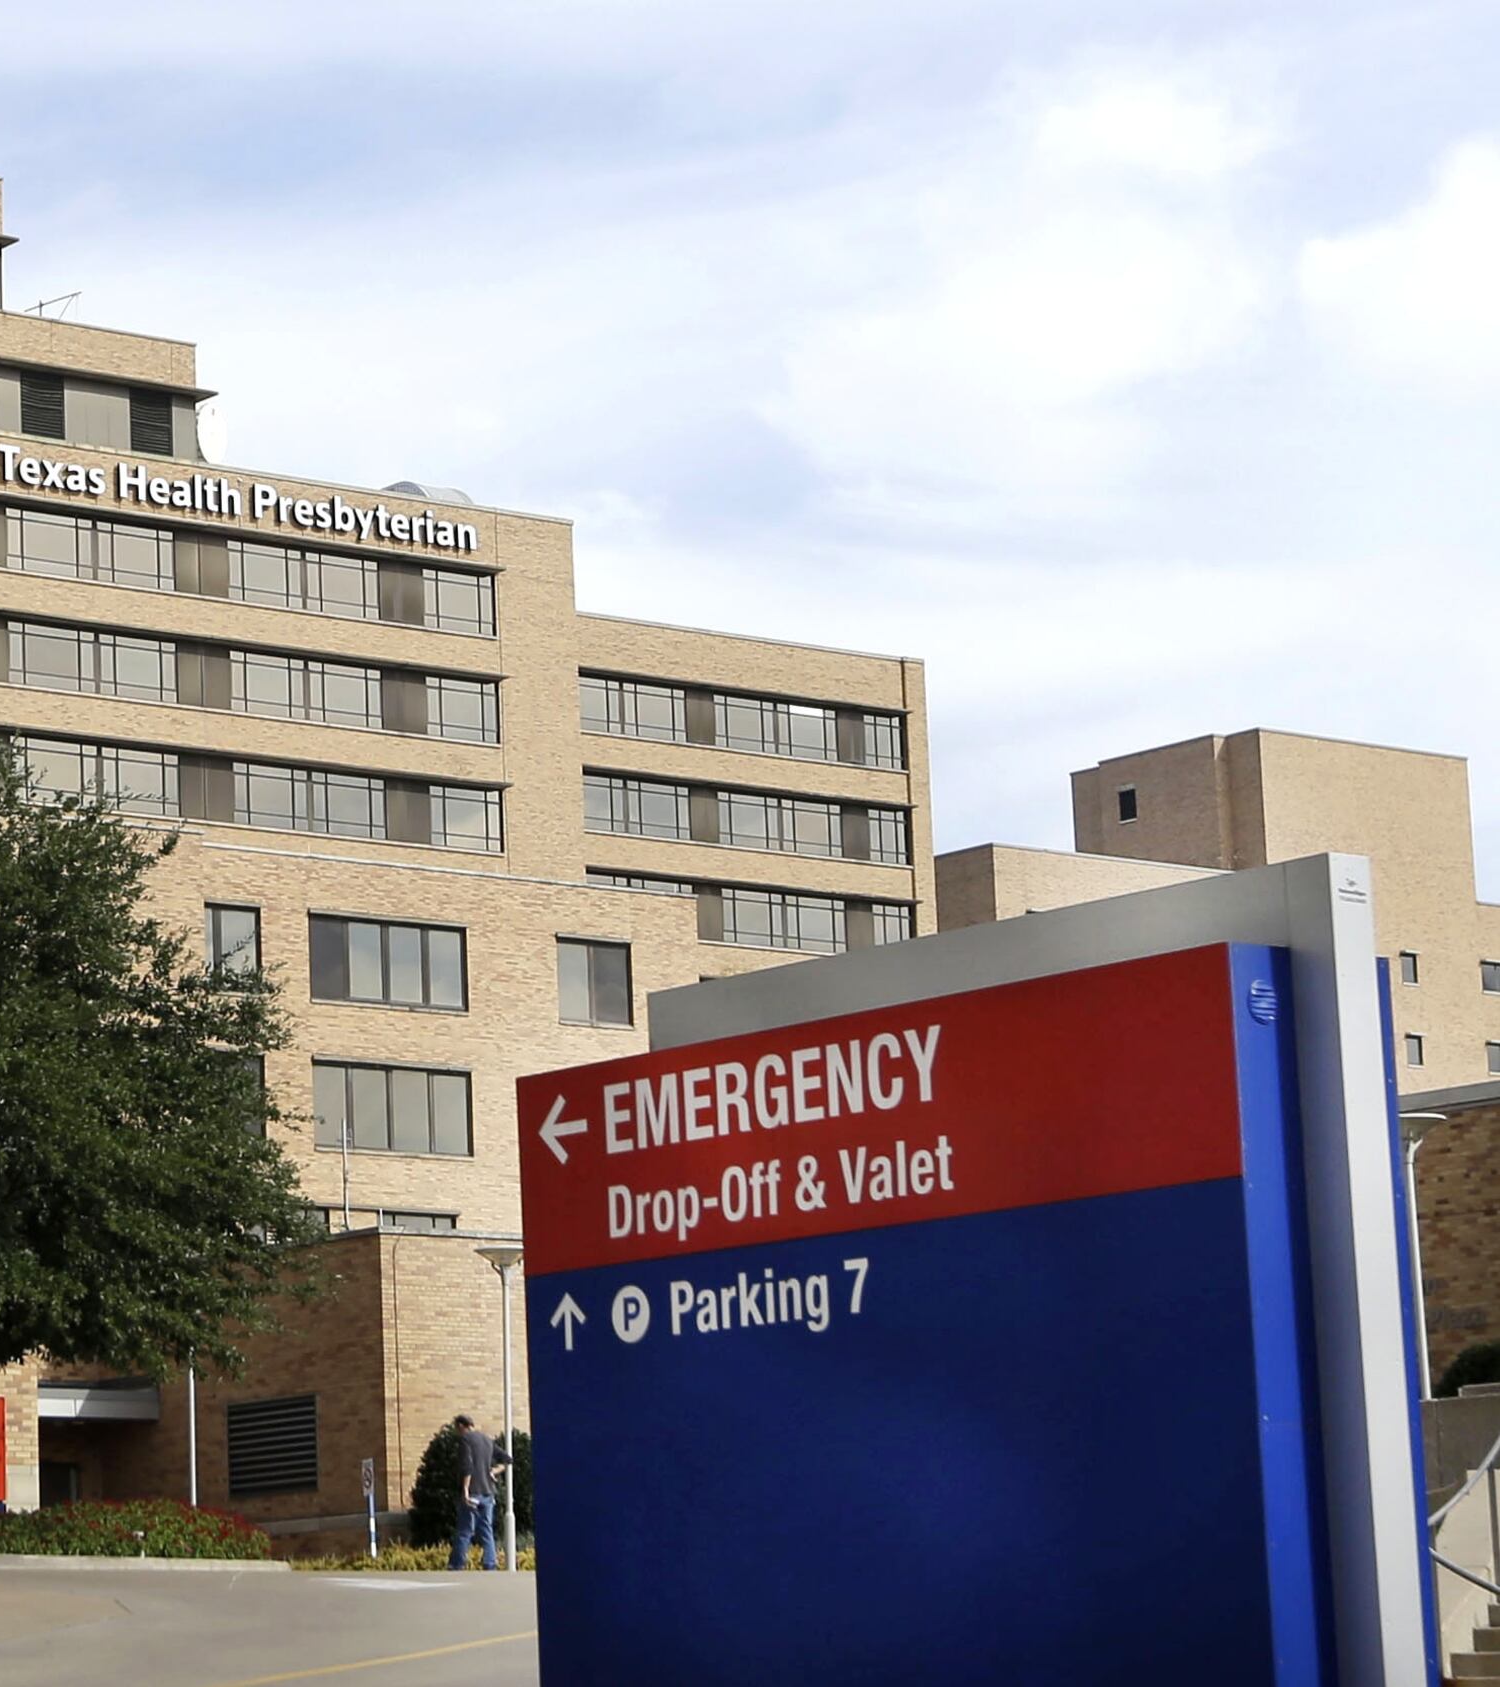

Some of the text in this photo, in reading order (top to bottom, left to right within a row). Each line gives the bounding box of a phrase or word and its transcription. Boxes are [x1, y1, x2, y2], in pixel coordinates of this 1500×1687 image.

[118, 462, 242, 516] Health
[253, 483, 479, 551] Presbyterian
[604, 1025, 940, 1154] EMERGENCY
[608, 1135, 954, 1241] Drop-Off & Valet
[670, 1268, 829, 1335] Parking
[843, 1257, 869, 1315] 7
